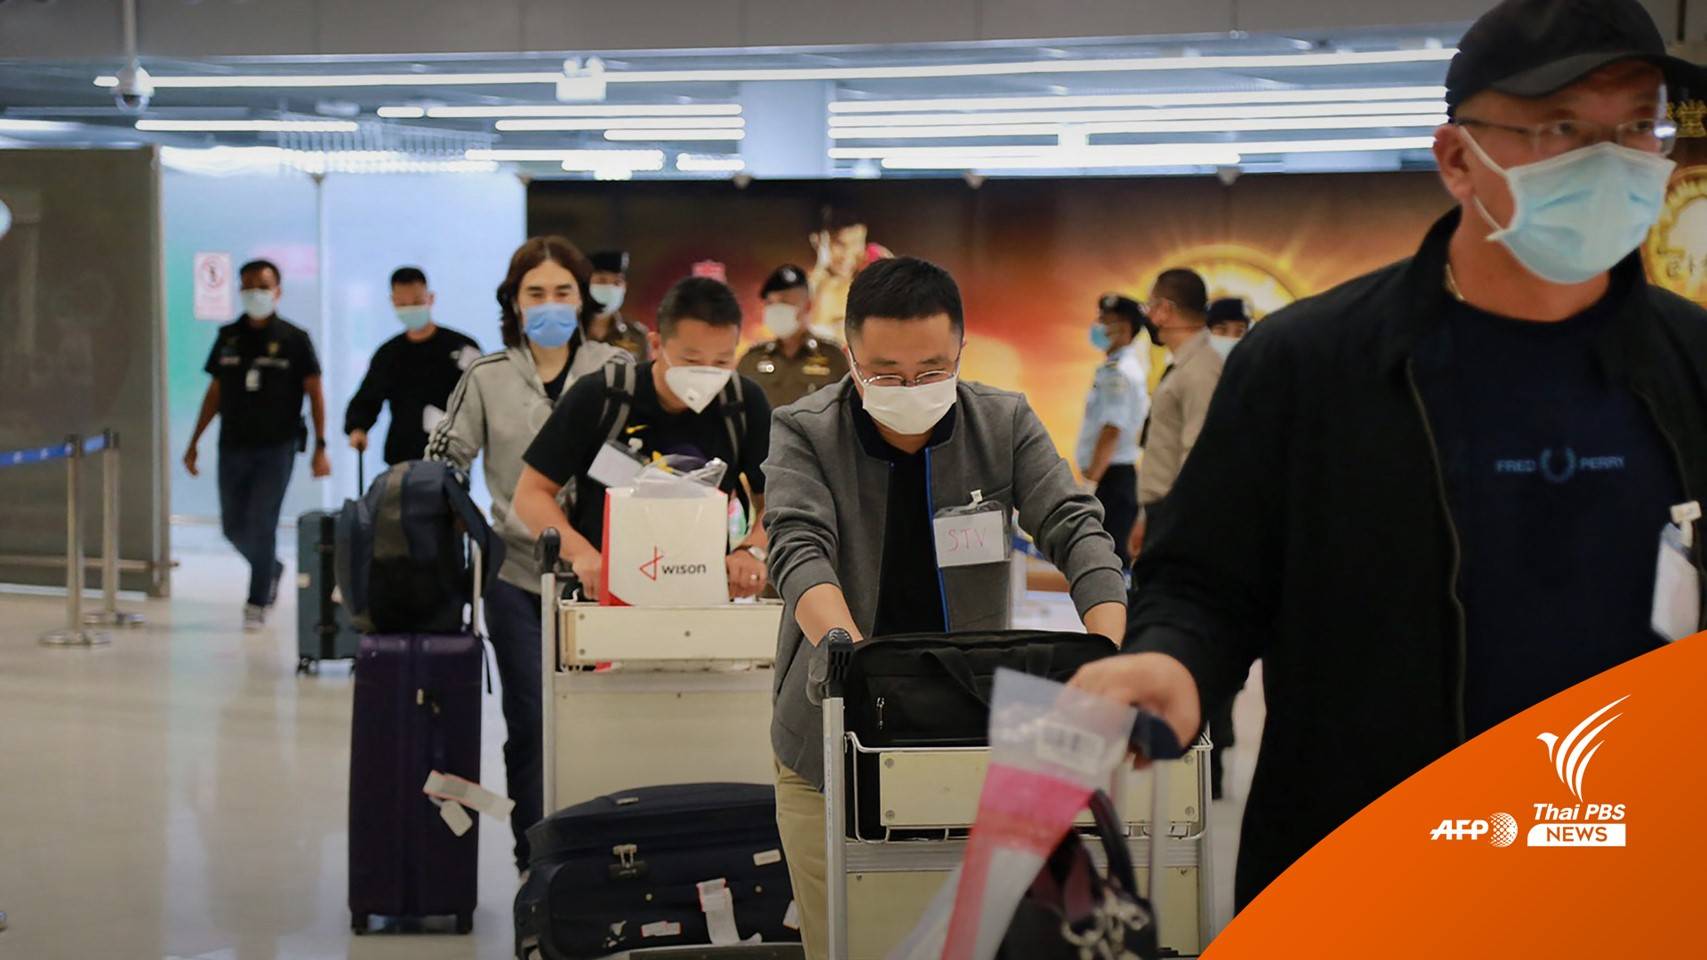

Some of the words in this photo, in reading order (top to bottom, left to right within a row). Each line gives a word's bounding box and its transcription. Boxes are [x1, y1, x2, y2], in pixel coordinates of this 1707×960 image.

[1496, 459, 1536, 474] FRED
[1579, 456, 1624, 471] PERRY
[948, 527, 987, 553] STV
